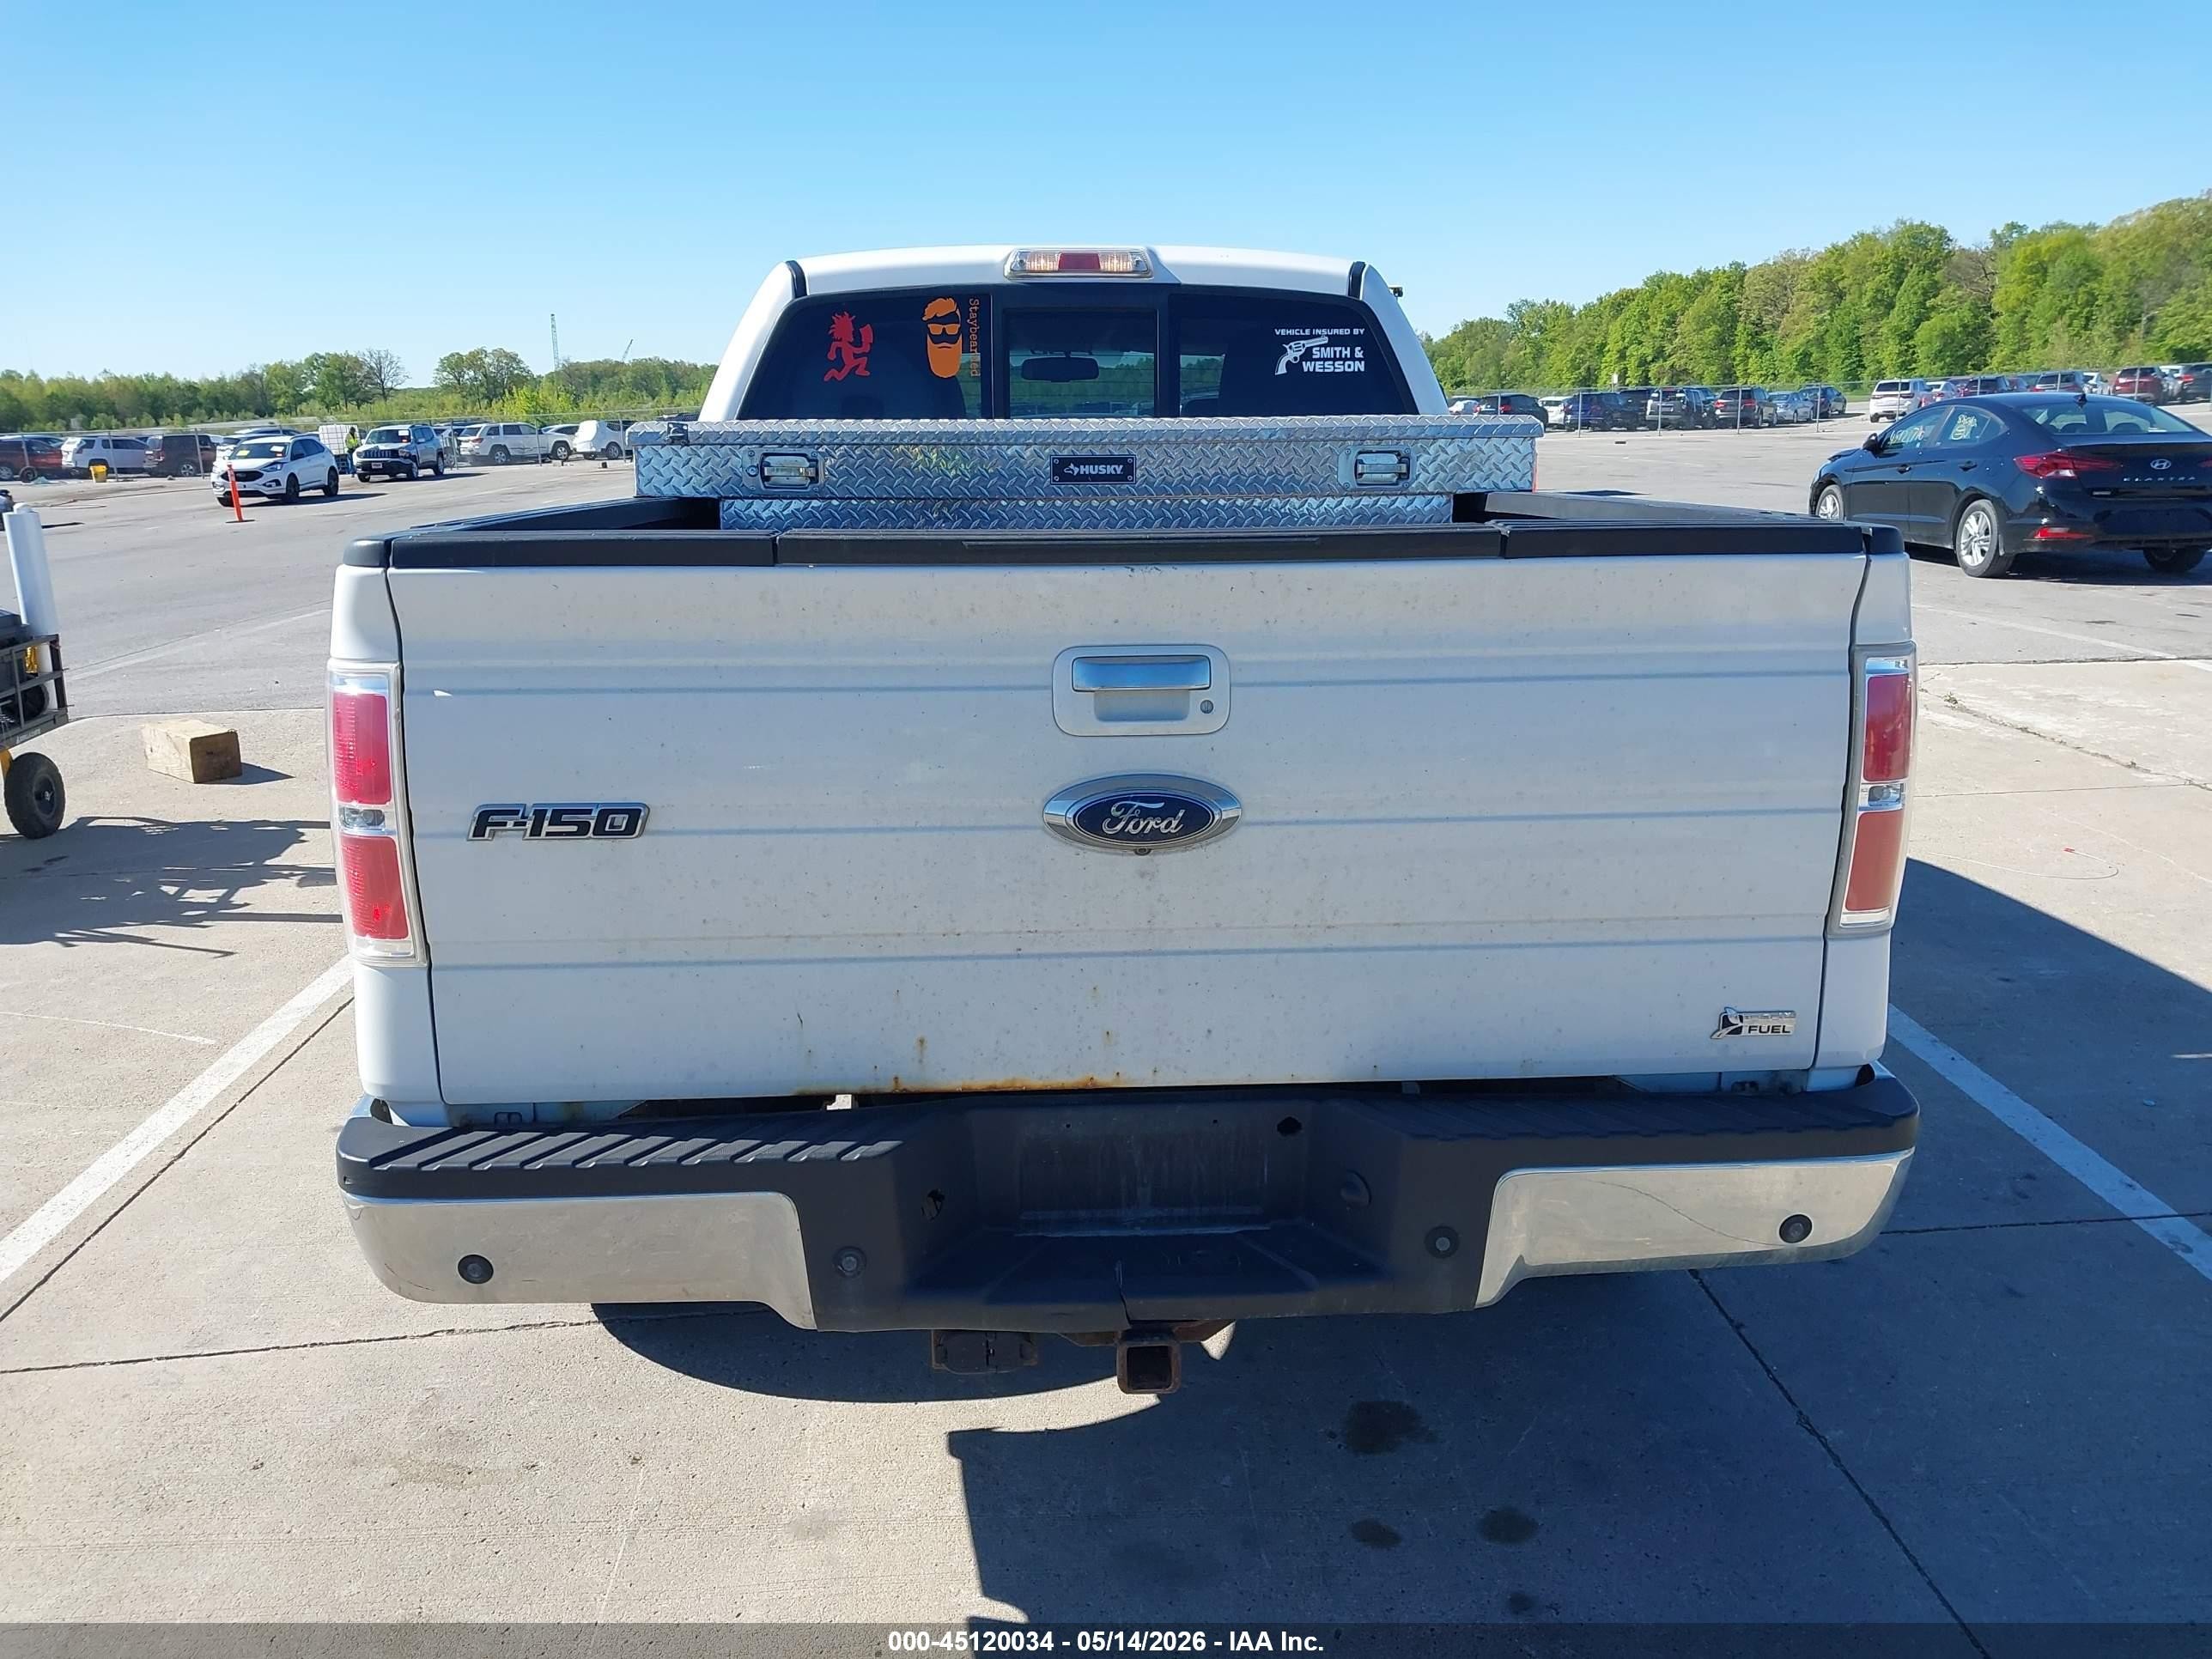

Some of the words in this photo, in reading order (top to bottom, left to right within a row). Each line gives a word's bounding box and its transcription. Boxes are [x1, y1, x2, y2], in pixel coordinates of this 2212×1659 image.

[1312, 346, 1351, 358] SMITH
[1354, 346, 1364, 358] &
[1303, 361, 1364, 372] WESSON
[1079, 465, 1123, 475] HUSKY
[467, 802, 650, 841] F-150
[1102, 800, 1186, 836] Ford
[1747, 1024, 1791, 1035] FUEL
